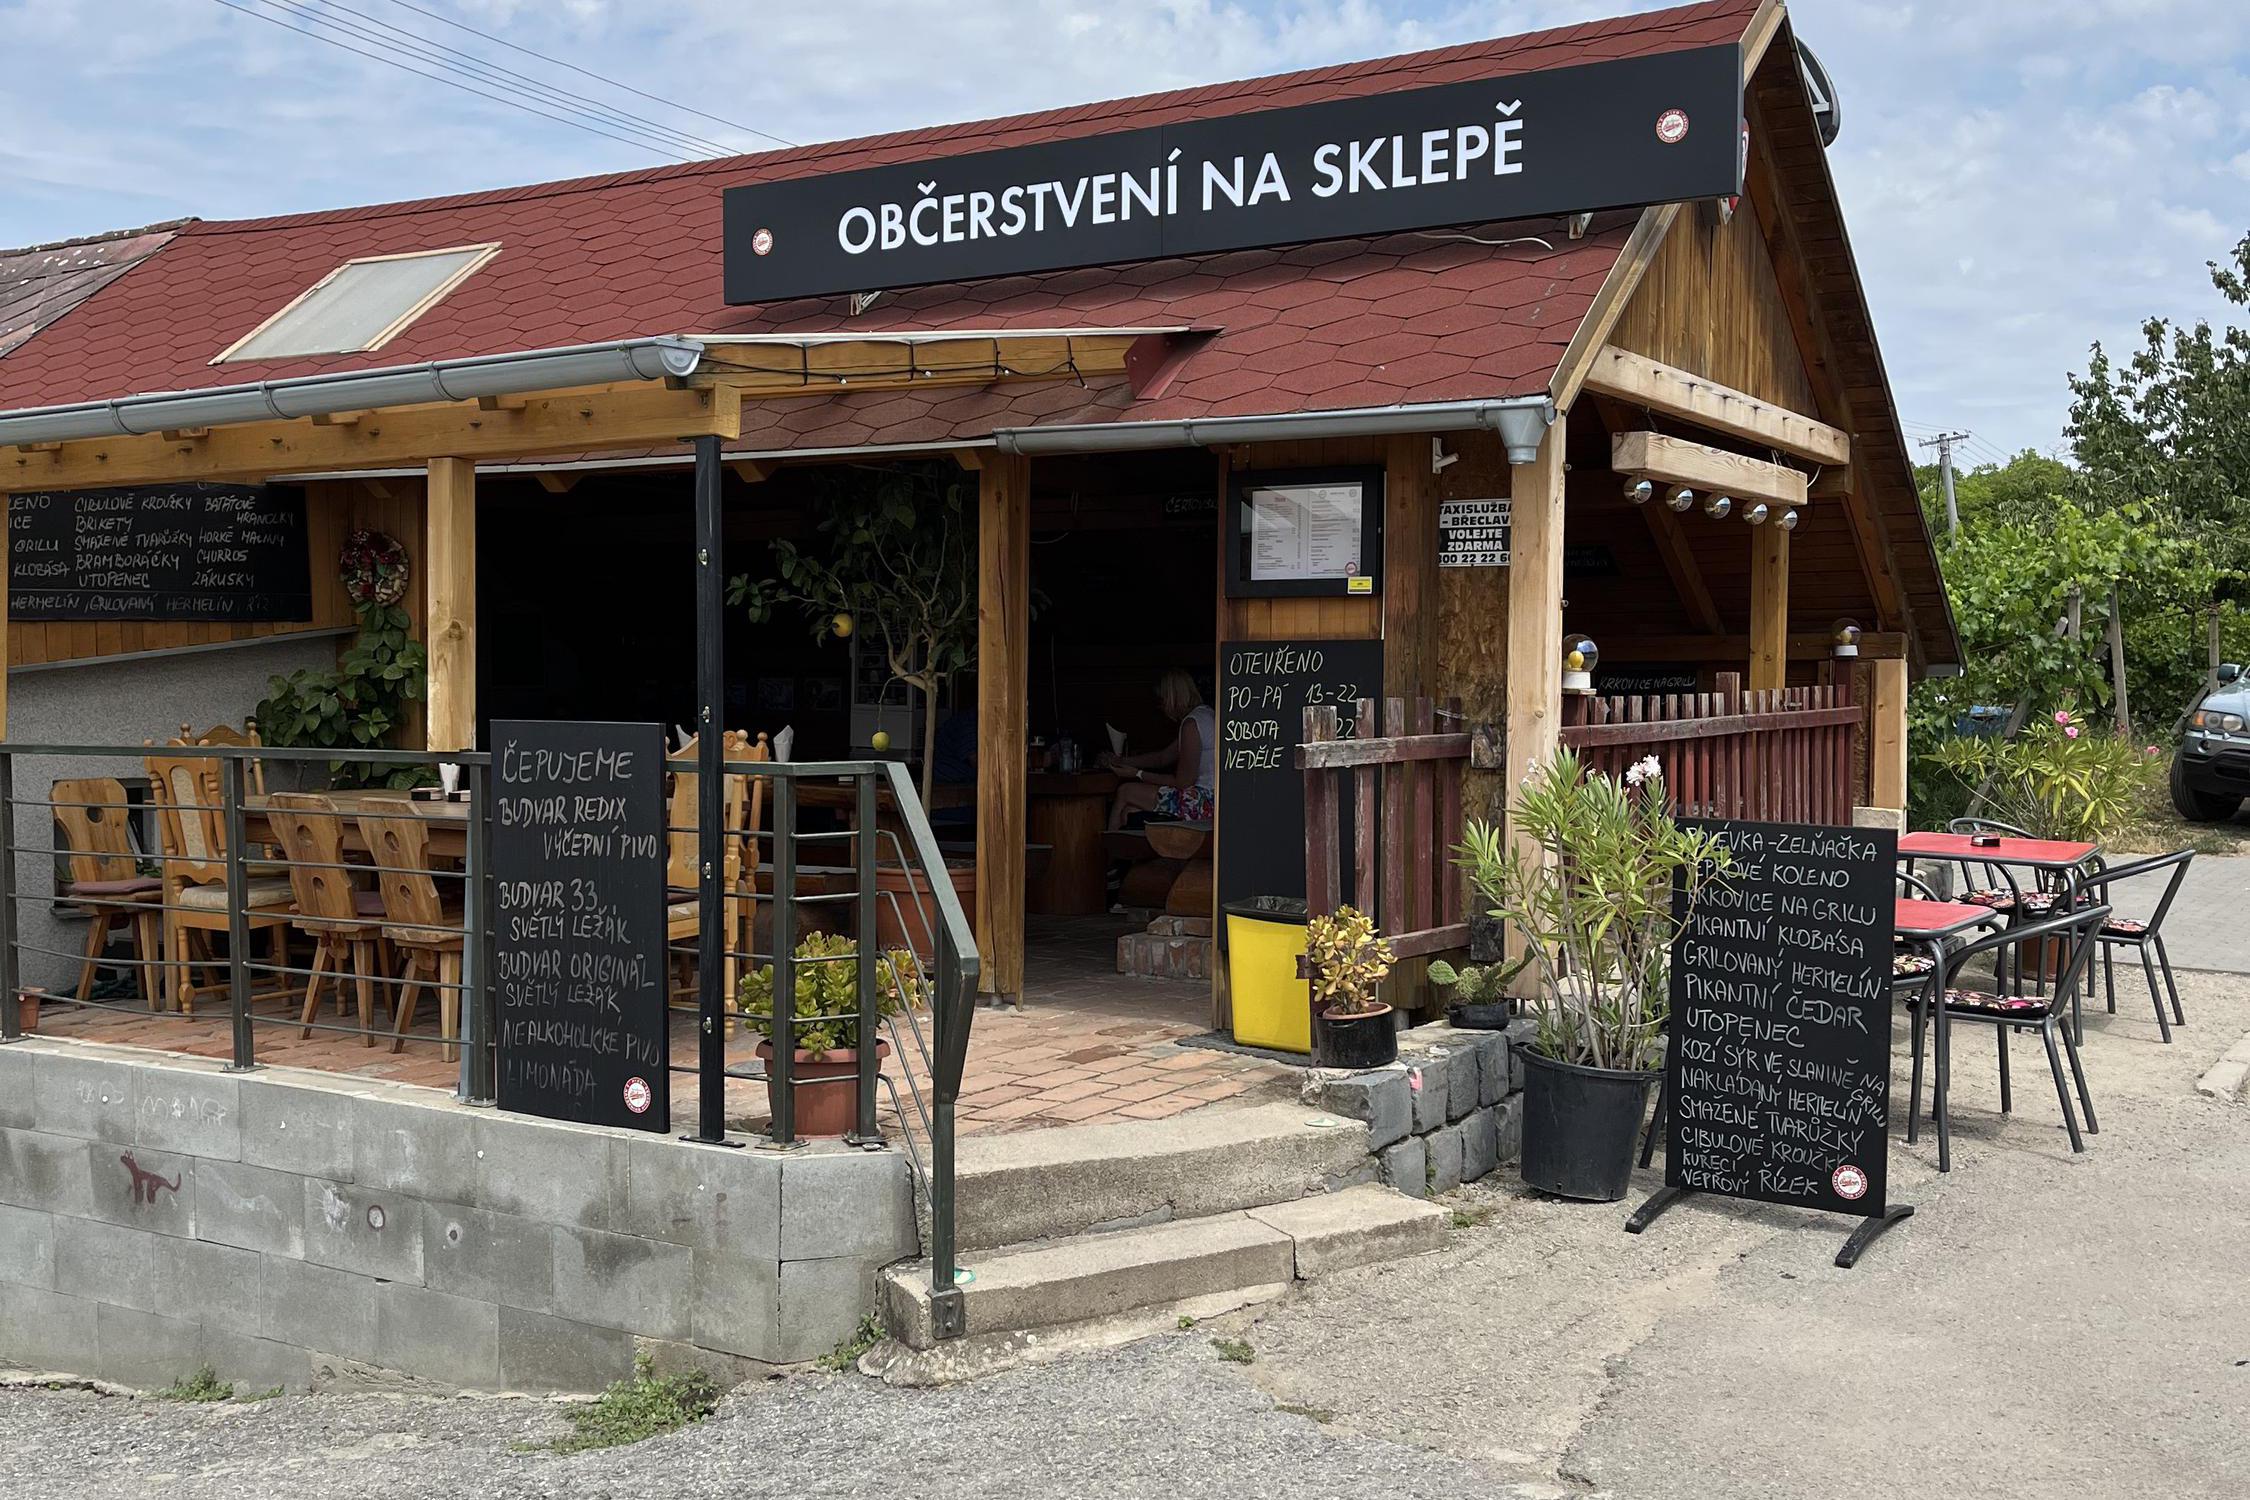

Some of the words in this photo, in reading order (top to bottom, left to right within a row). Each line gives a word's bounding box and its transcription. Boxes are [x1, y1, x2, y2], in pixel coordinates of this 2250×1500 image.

[838, 146, 1182, 255] OBČERSTVENÍ
[1202, 151, 1291, 211] NA
[1311, 98, 1524, 198] SKLEPĚ
[74, 492, 133, 512] CIBULOVÉ
[140, 493, 192, 511] KROUŽKY
[75, 516, 133, 533] BRIKETY
[199, 525, 233, 544] HORKÉ
[1448, 528, 1503, 540] VOLEJTE
[1452, 515, 1509, 526] BŘECLAV
[75, 547, 180, 572] BRAMBORÁČKY
[197, 549, 248, 566] CHURROS
[1447, 540, 1503, 551] ZDARMA
[1462, 554, 1476, 563] 22
[1480, 553, 1496, 562] 22
[14, 561, 70, 577] KLOBÁSA
[79, 572, 150, 588] UTOPENEC
[192, 571, 254, 588] ZÁKUSKY
[1230, 644, 1324, 676] OTEVŘENO
[1228, 682, 1290, 712] PO-PÁ
[1305, 683, 1357, 703] 13-22
[1600, 677, 1650, 690] KRKOVICE
[1225, 719, 1280, 742] SOBOTA
[502, 739, 633, 783] ČEPUJEME
[1225, 744, 1285, 771] NEDĚLE
[499, 796, 568, 828] BUDVAR
[574, 796, 627, 824] REDIX
[544, 825, 619, 861] VÝČEPNÍ
[620, 834, 657, 860] PIVO
[1772, 863, 1850, 888] KOLENO
[499, 881, 565, 909] BUDVAR
[570, 878, 598, 911] 33
[1687, 886, 1773, 912] KRKOVICE
[1782, 896, 1808, 917] NA
[1813, 898, 1877, 926] GRILU
[509, 907, 565, 942] SVĚTLÝ
[572, 905, 631, 944] LEŽÁK
[1685, 911, 1773, 942] PIKANTNÍ
[1778, 927, 1864, 958] KLOBÁSA
[499, 949, 562, 981] BUDVAR
[570, 952, 655, 991] ORIGINÁL
[1684, 940, 1784, 979] GRILOVANÝ
[505, 979, 559, 1008] SVĚTLÝ
[567, 983, 622, 1014] LEŽÁK
[1684, 974, 1782, 1012] PIKANTNÍ
[1786, 990, 1868, 1034] ČEDAR
[1687, 1006, 1804, 1048] UTOPENEC
[626, 1032, 660, 1067] PIVO
[506, 1059, 598, 1096] LIMONÁDA
[1681, 1035, 1722, 1062] KOZÍ
[1724, 1038, 1760, 1072] SÝR
[1764, 1053, 1782, 1074] VE
[1787, 1058, 1859, 1090] SLANINĚ
[1860, 1073, 1885, 1097] NA
[1681, 1065, 1782, 1107] NAKLÁDANÝ
[1851, 1088, 1886, 1127] GRILU
[1680, 1094, 1762, 1130] SMAŽENÉ
[1765, 1111, 1865, 1156] TVARŮŽKY
[1681, 1127, 1765, 1156] CIBULOVÉ
[1682, 1149, 1745, 1173] KUŘECÍ
[1758, 1162, 1819, 1196] ŘÍZEK
